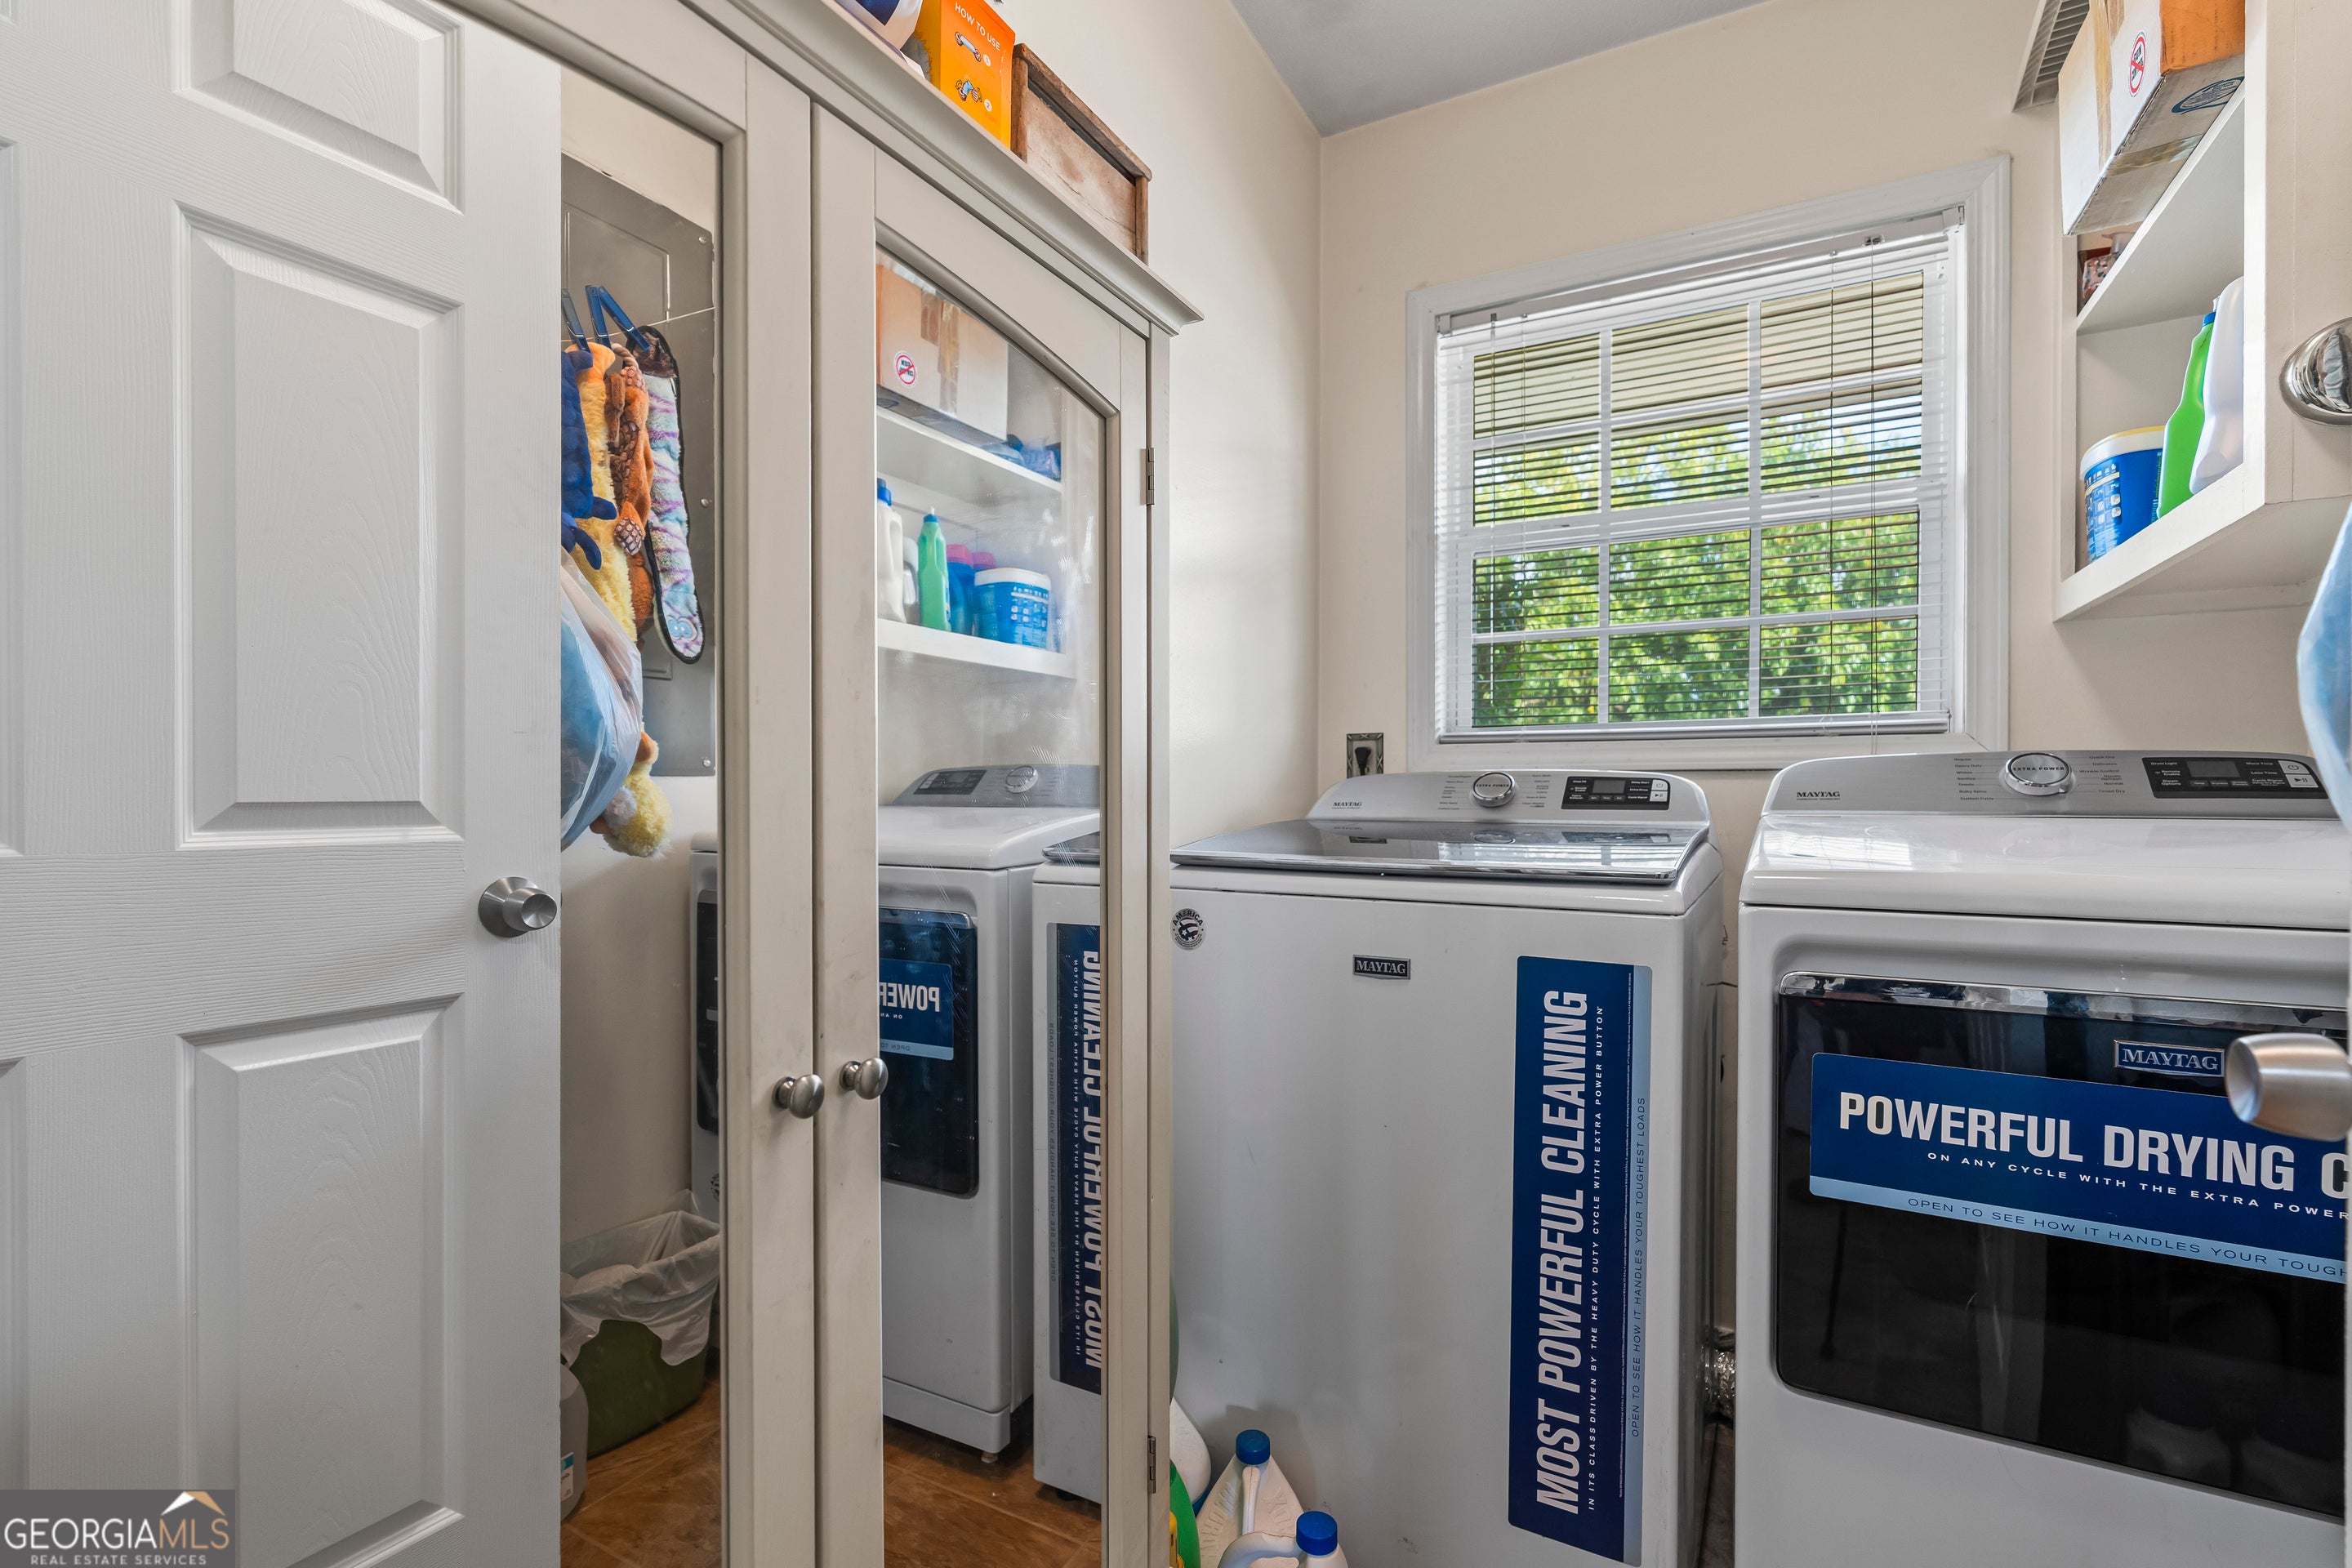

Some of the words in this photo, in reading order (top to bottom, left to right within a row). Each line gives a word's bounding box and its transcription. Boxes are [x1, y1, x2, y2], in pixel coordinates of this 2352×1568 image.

[955, 2, 975, 25] HOW
[976, 21, 986, 37] TO
[987, 33, 1000, 51] USE
[1172, 910, 1204, 926] AMERICA
[1356, 960, 1405, 974] MAYTAG
[2122, 1048, 2219, 1071] MAYTAG
[1540, 990, 1588, 1174] CLEANING
[1637, 1098, 1646, 1137] LOADS
[1839, 1091, 2083, 1162] POWERFUL
[2104, 1125, 2295, 1192] DRYING
[1636, 1143, 1645, 1205] TOUGHEST
[1927, 1152, 1950, 1162] ON
[1961, 1157, 1996, 1169] ANY
[2007, 1164, 2067, 1180] CYCLE
[2078, 1174, 2127, 1187] WITH
[2139, 1183, 2177, 1196] THE
[2190, 1190, 2260, 1208] EXTRA
[2274, 1202, 2349, 1220] POWER
[1635, 1211, 1643, 1244] YOUR
[1908, 1197, 1953, 1213] OPEN
[1962, 1206, 1983, 1218] TO
[1991, 1212, 2025, 1225] SEE
[2034, 1218, 2075, 1232] HOW
[2084, 1227, 2100, 1237] IT
[2109, 1230, 2201, 1254] HANDLES
[2210, 1247, 2267, 1265] YOUR
[1538, 1189, 1584, 1394] POWERFUL
[1634, 1249, 1642, 1304] HANDLES
[1633, 1311, 1642, 1320] IT
[1633, 1326, 1642, 1352] HOW
[1590, 1356, 1597, 1371] BY
[1633, 1357, 1641, 1379] SEE
[1632, 1385, 1640, 1400] TO
[1632, 1405, 1640, 1437] OPEN
[1536, 1397, 1580, 1515] MOST
[1588, 1498, 1595, 1511] IN
